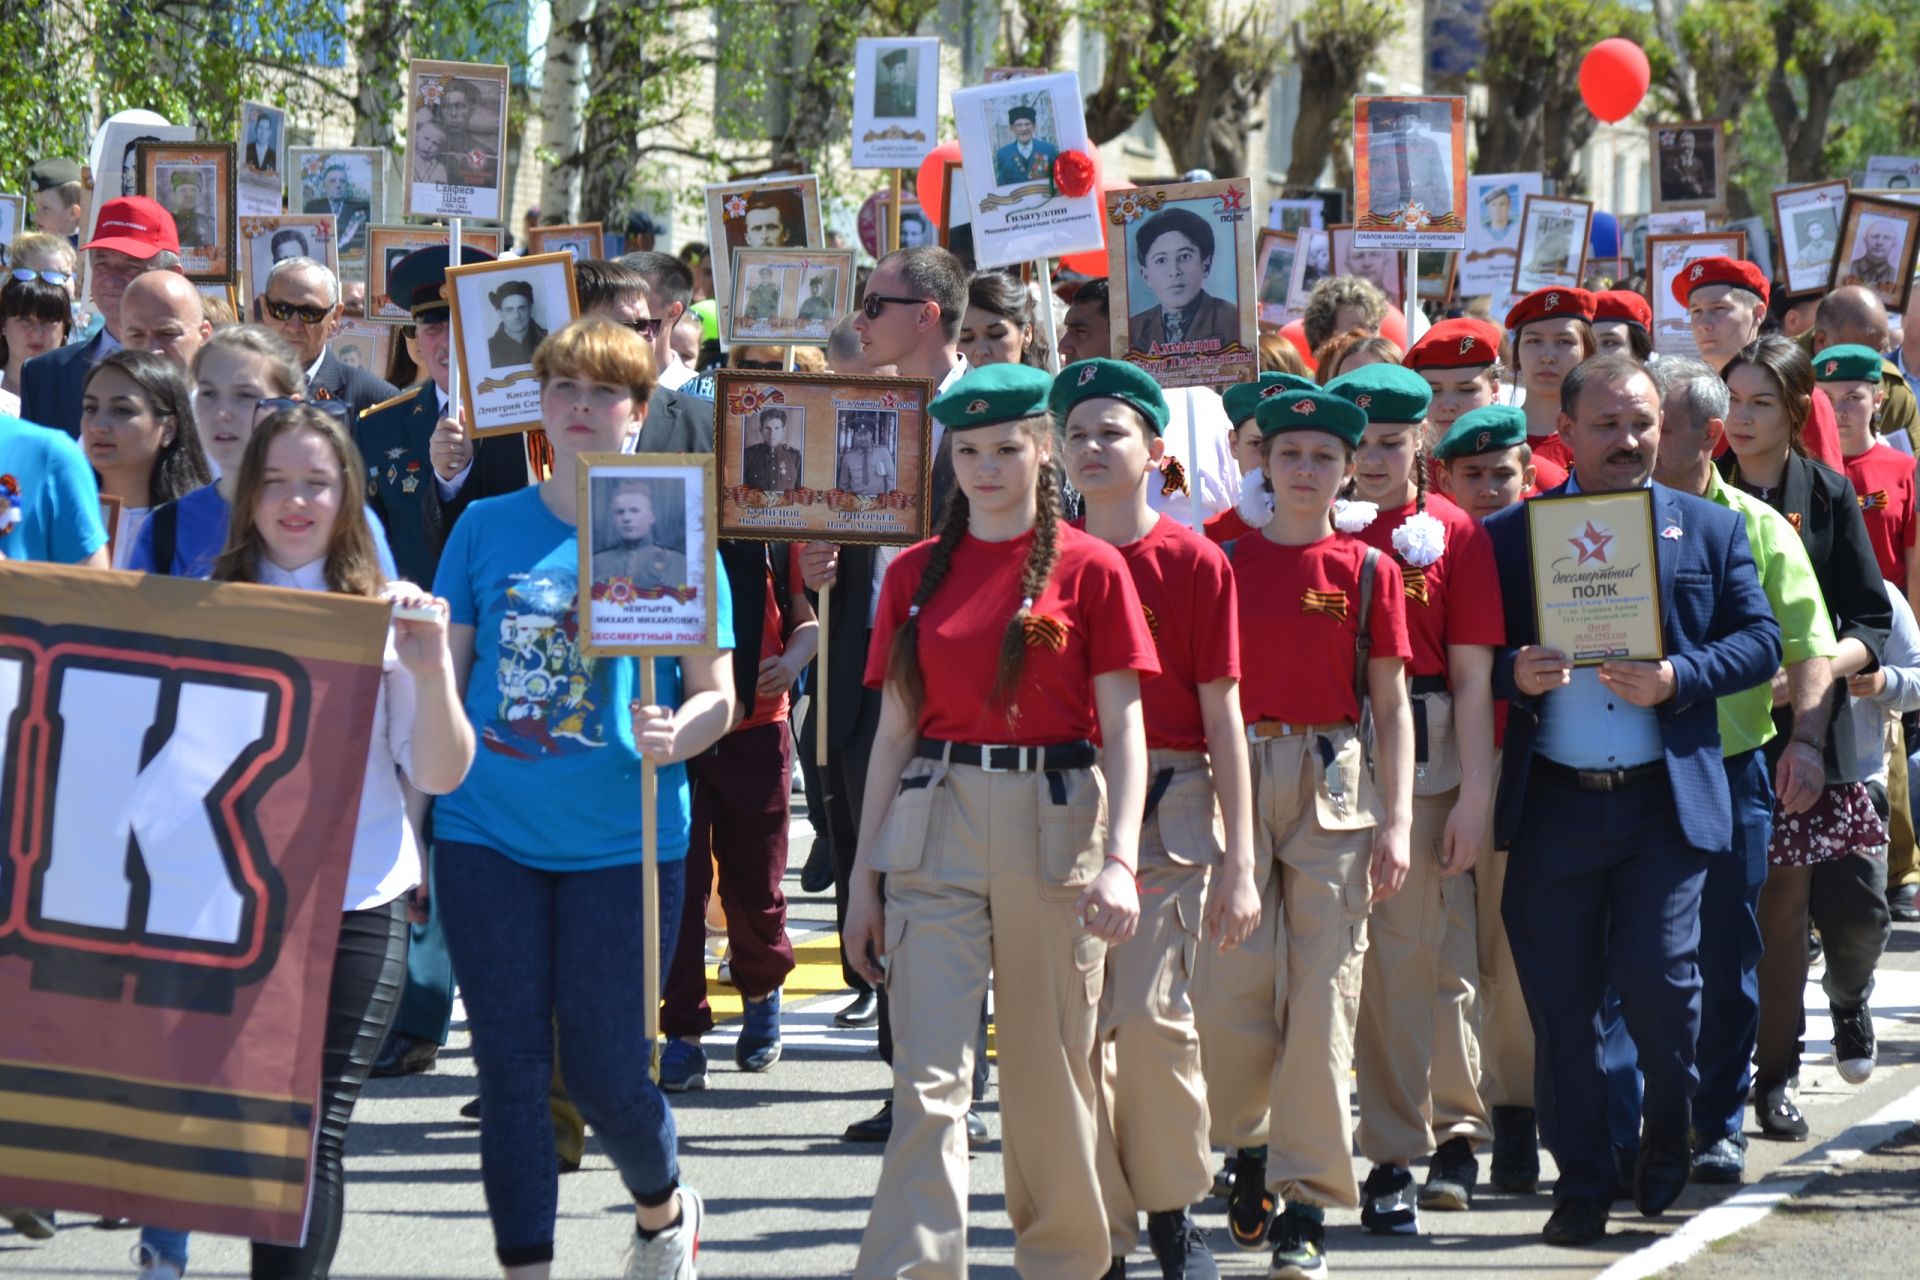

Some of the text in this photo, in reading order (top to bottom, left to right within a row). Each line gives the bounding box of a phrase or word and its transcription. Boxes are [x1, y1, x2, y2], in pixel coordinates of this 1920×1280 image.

[1005, 207, 1068, 224] Гизатуллин
[1383, 232, 1416, 241] АНАТОЛИЙ
[1419, 233, 1456, 241] АРХИПОВИЧ
[1147, 339, 1222, 356] Ахмедов
[506, 389, 540, 400] Киселе
[478, 402, 521, 416] Дмитрий
[746, 507, 800, 518] КУЗНЕЦОВ
[837, 510, 896, 521] ГРИГОРЬЕВ
[1551, 556, 1641, 584] бессмертный
[1572, 583, 1618, 599] ПОЛК
[596, 614, 700, 624] МИХАИЛ МИХАЙЛОВИЧ
